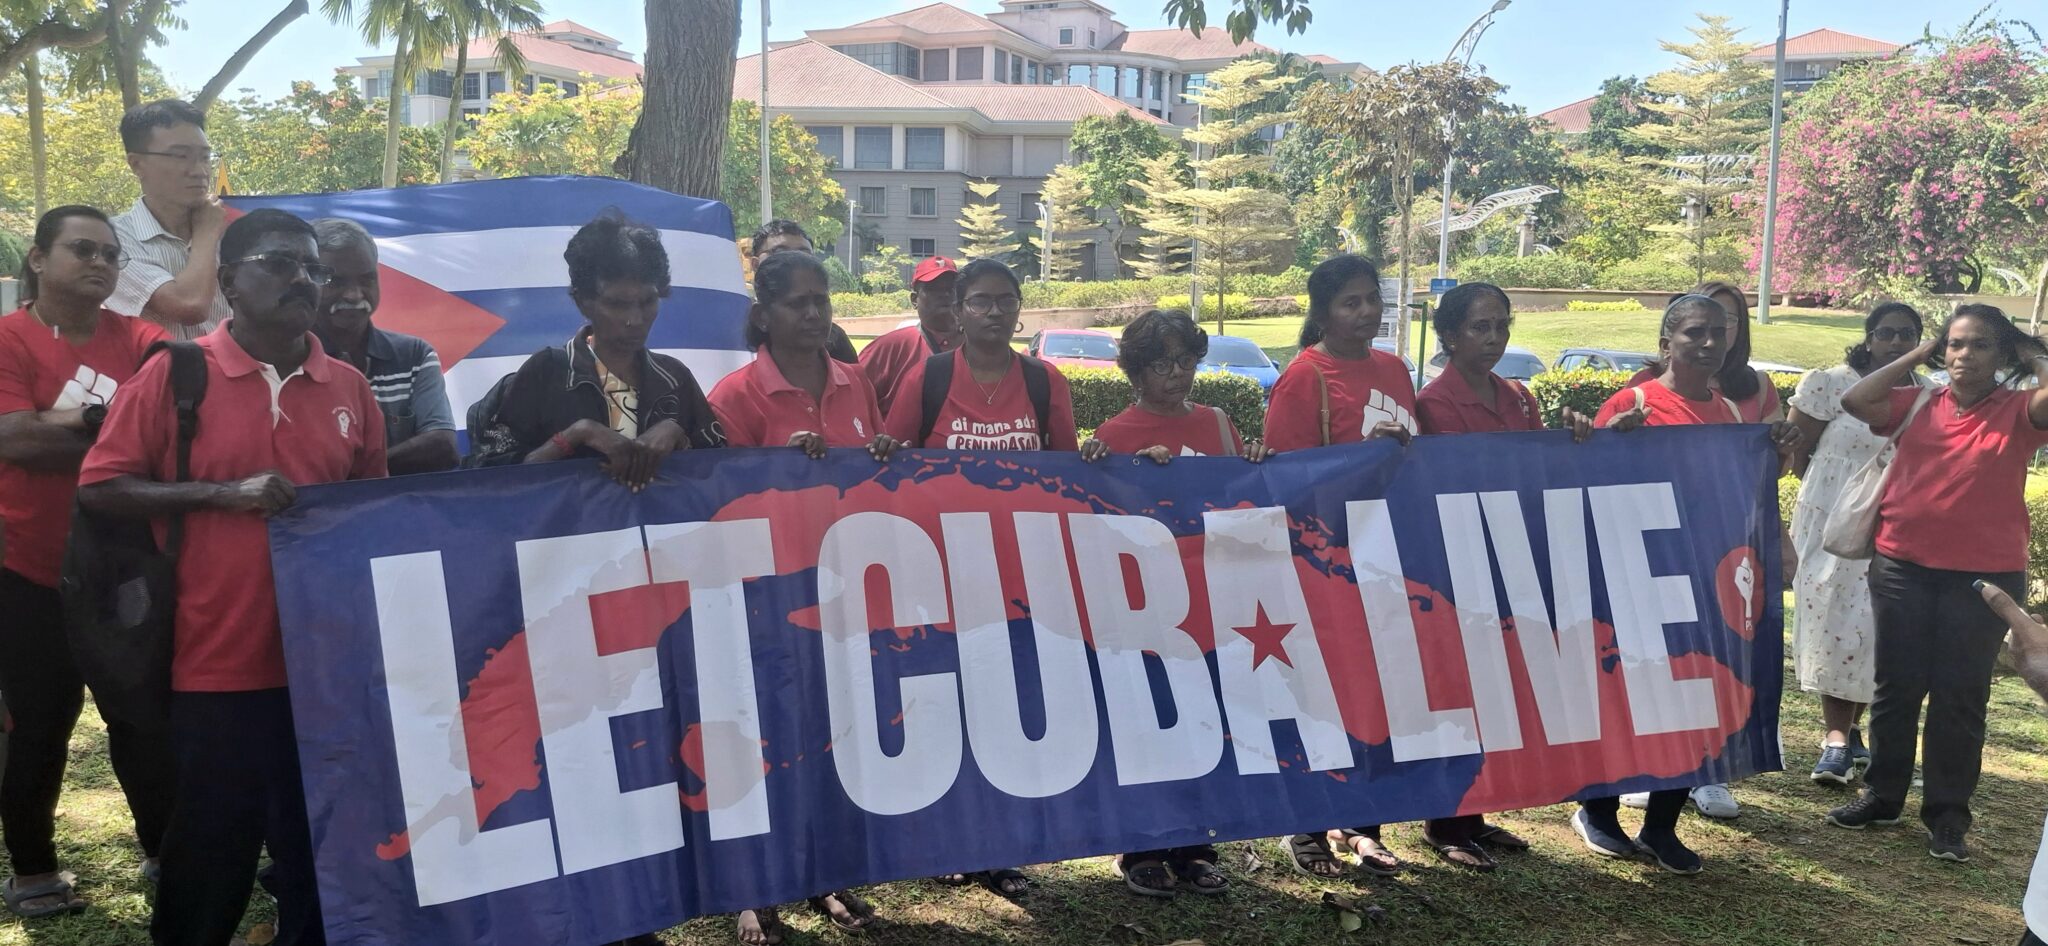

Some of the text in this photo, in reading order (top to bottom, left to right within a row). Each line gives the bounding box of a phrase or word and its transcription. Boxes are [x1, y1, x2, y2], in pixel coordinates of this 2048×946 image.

[952, 417, 967, 431] di
[972, 422, 1011, 434] mana
[955, 434, 1038, 451] PENINDASAN
[370, 482, 1719, 908] LET CUBA LIVE
